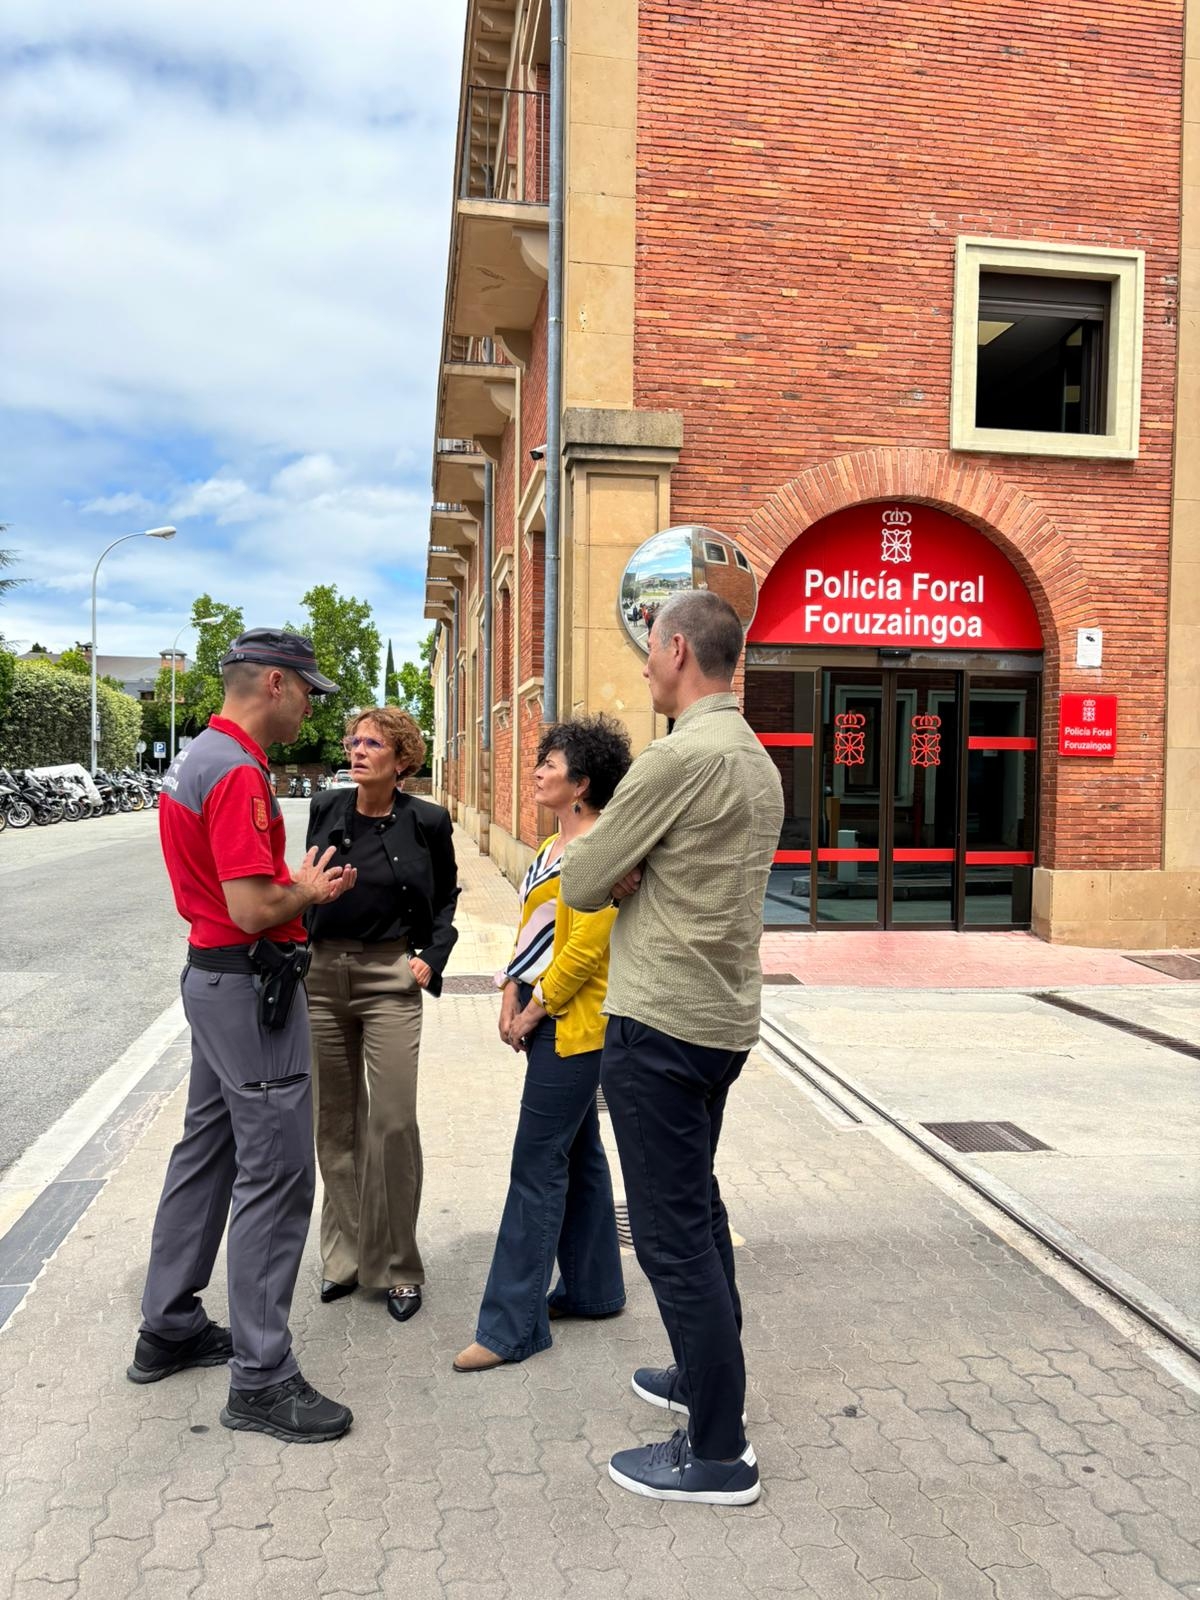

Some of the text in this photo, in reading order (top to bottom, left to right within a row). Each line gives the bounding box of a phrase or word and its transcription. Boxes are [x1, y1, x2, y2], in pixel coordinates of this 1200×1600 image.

[804, 568, 985, 603] Policía Foral
[804, 604, 983, 644] Foruzaingoa
[1064, 726, 1113, 737] Policía Foral
[1064, 740, 1112, 752] Foruzaingoa
